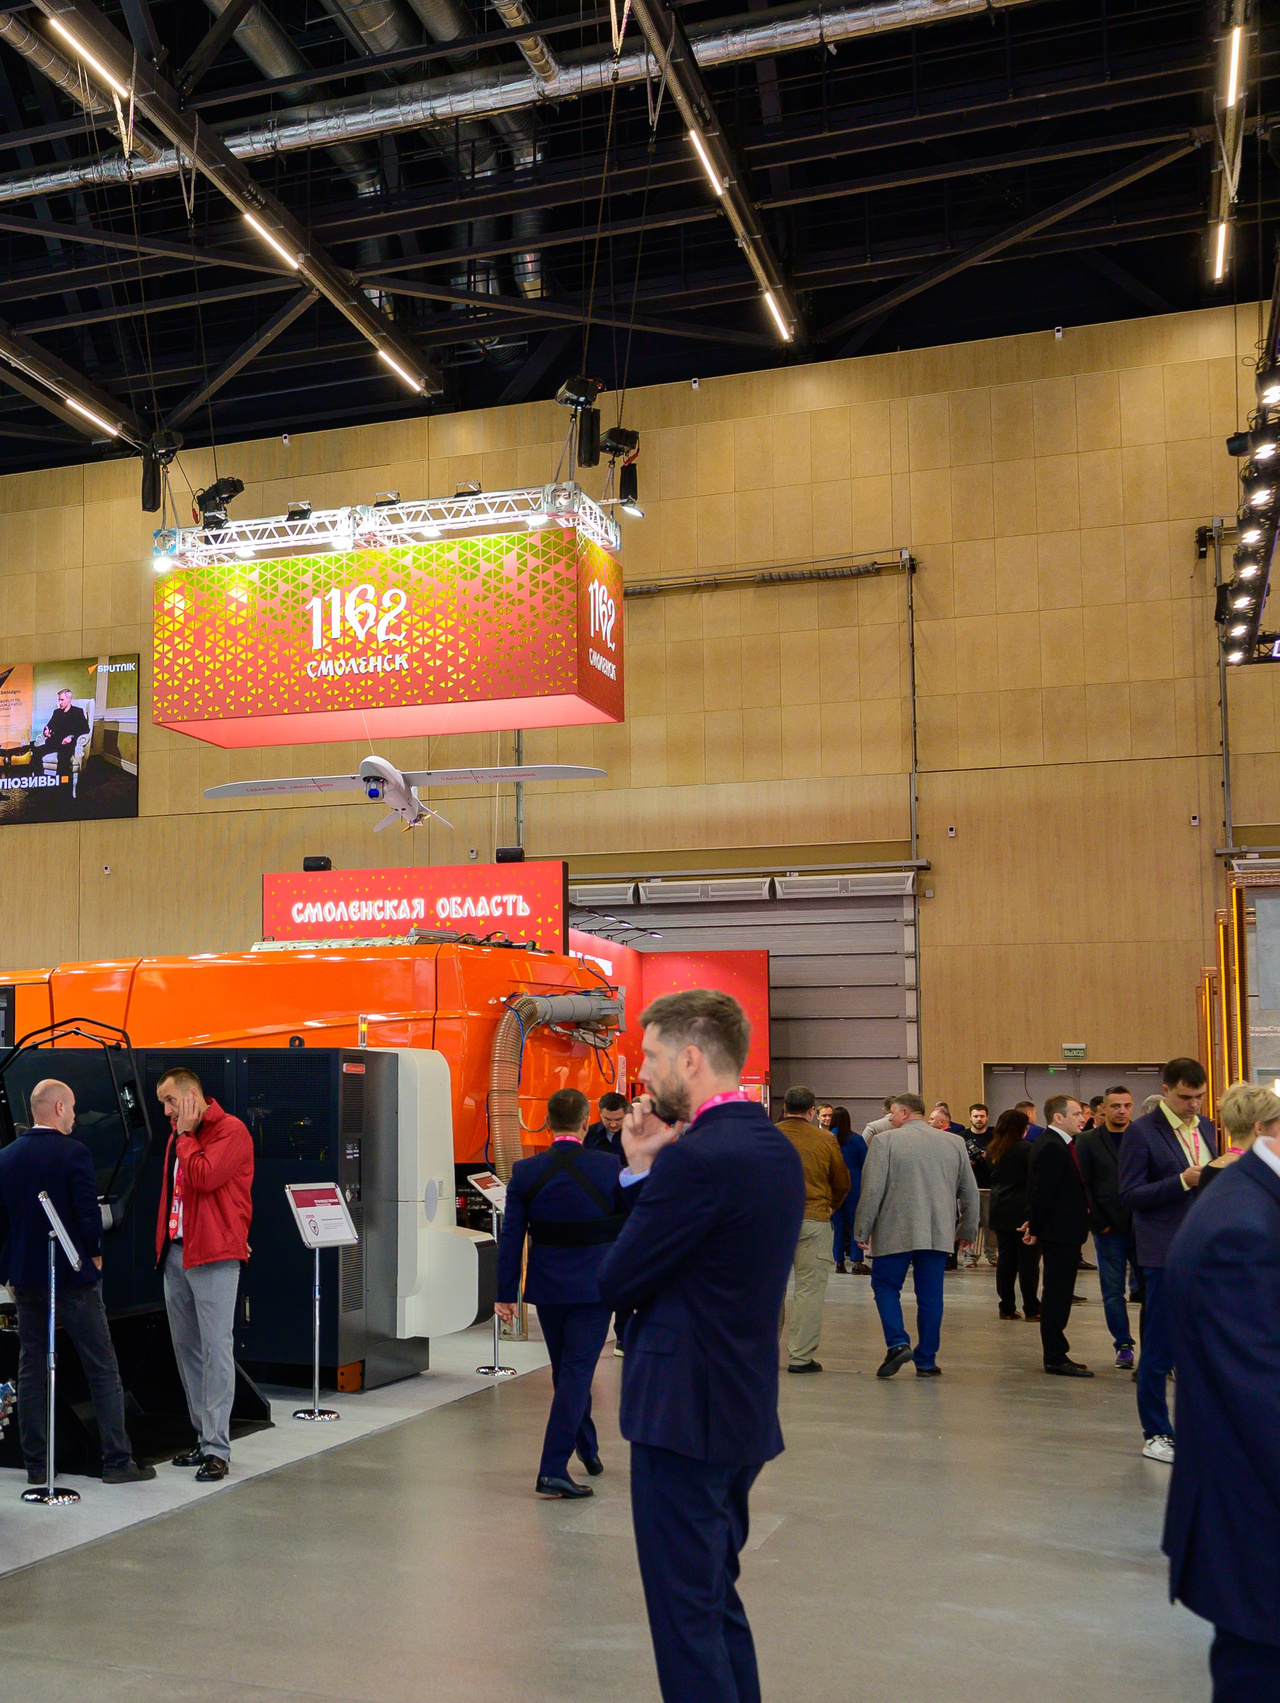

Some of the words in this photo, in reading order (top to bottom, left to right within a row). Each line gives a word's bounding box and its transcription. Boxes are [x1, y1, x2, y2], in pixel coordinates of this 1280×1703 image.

[305, 583, 407, 650] 1162
[588, 578, 616, 652] 1162
[97, 662, 136, 673] SPUTNIK
[307, 652, 410, 679] СМОЛЕНСК
[292, 898, 425, 923] СМОЛЕНСКАЯ
[435, 894, 531, 918] ОБЛАСТЬ
